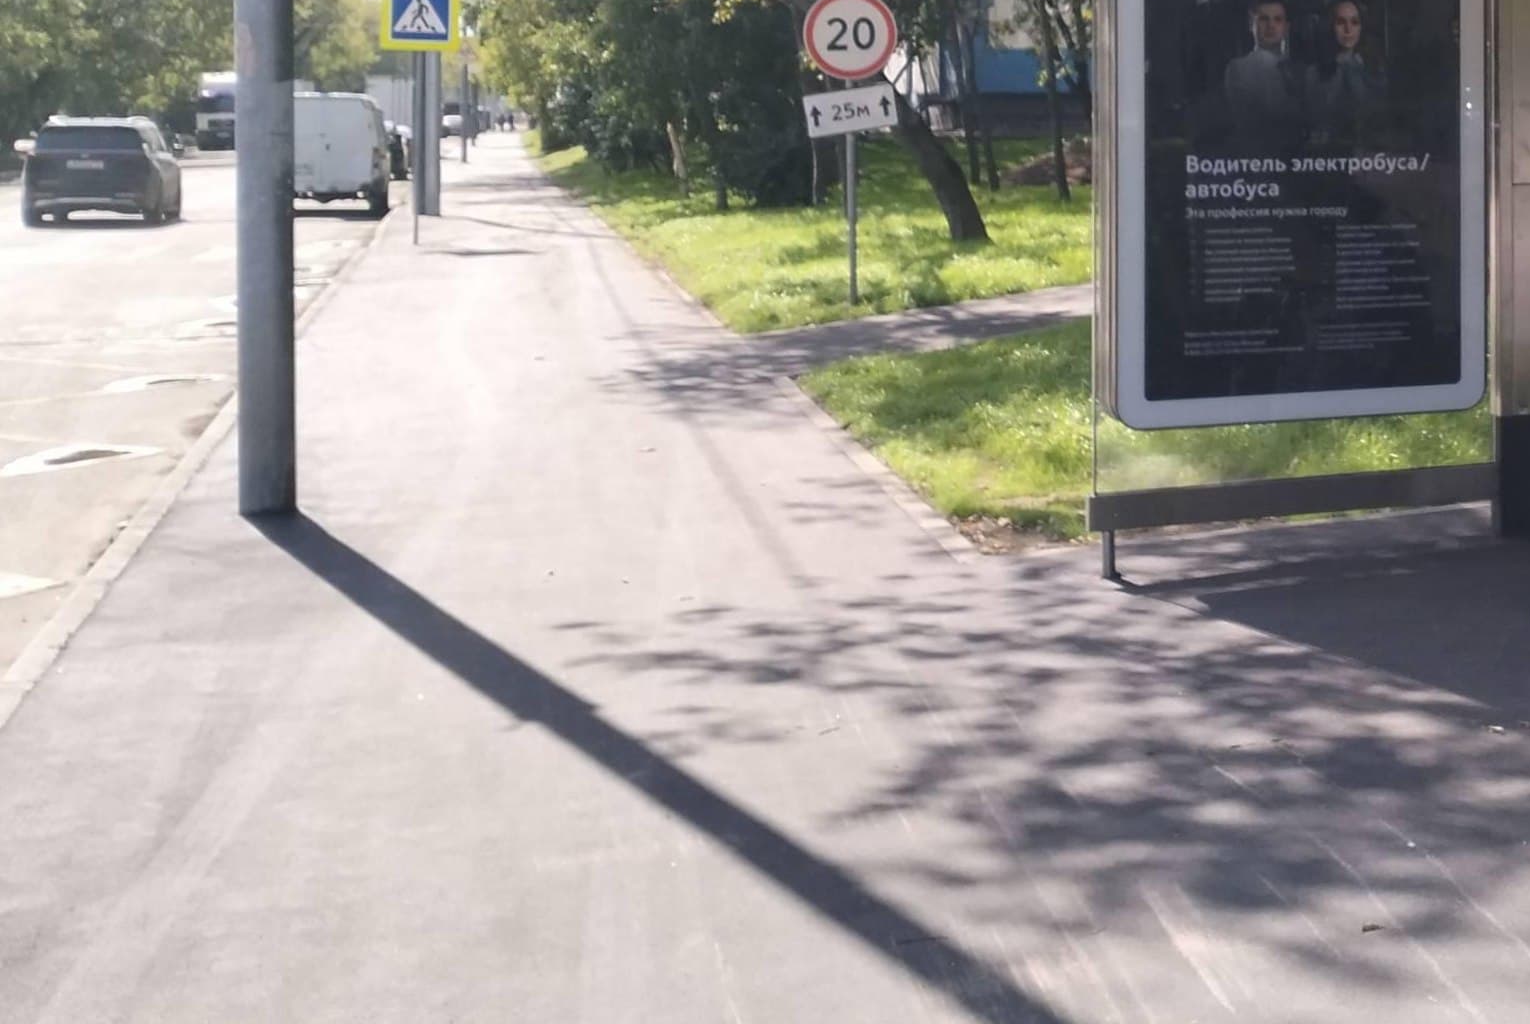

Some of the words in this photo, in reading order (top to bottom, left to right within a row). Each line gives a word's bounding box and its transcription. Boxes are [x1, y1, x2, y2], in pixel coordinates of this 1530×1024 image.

[826, 16, 876, 52] 20
[1185, 154, 1287, 176] Водитель
[1291, 152, 1430, 175] электробуса/
[1185, 178, 1280, 201] автобуса
[1207, 206, 1270, 220] профессия
[1272, 207, 1308, 219] нужна
[1309, 206, 1349, 218] городу
